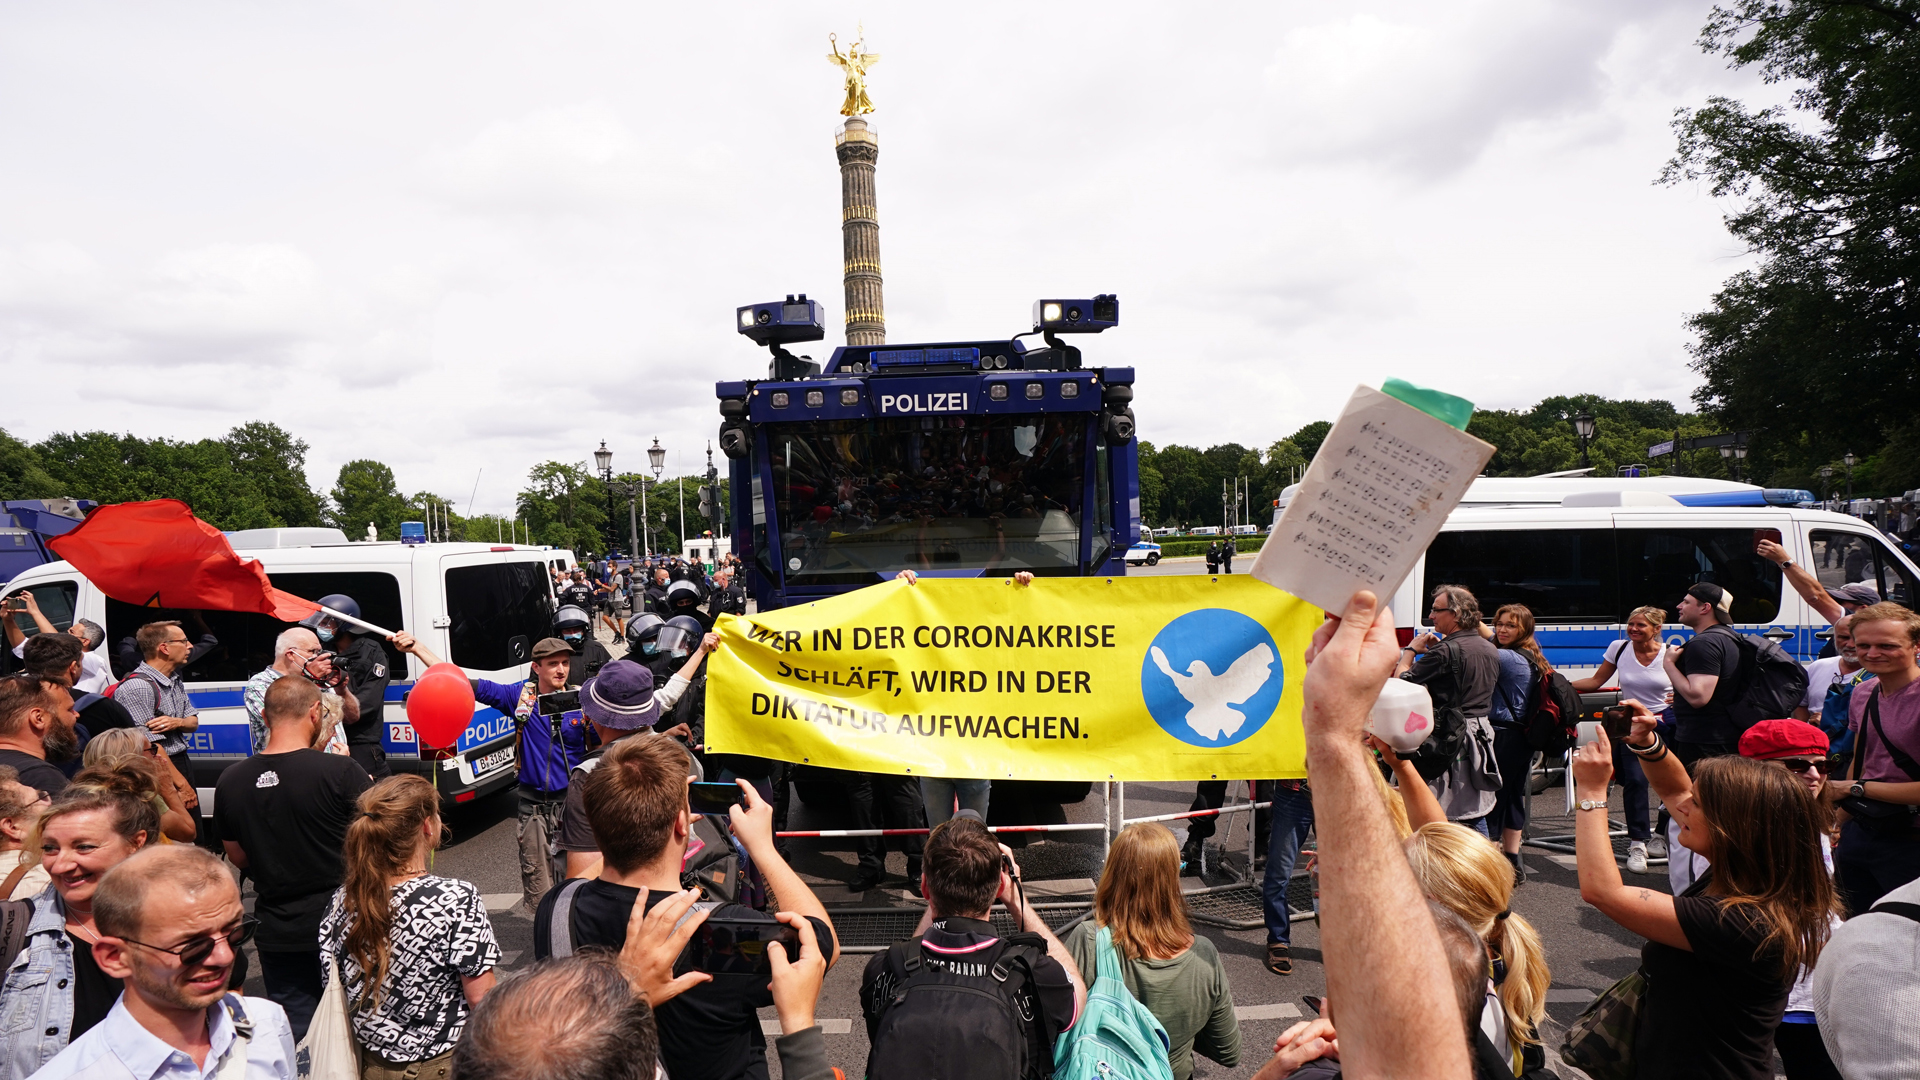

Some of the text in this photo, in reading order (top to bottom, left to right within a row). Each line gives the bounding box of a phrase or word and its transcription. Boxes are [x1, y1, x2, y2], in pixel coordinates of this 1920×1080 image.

[881, 392, 968, 413] POLIZEI
[747, 623, 1116, 652] WER IN DER CORONAKRISE
[777, 660, 1091, 697] SCHLÄFT, WIRD IN DER
[465, 716, 515, 746] POLIZE
[751, 692, 1090, 740] DIKTATUR AUFWACHEN.
